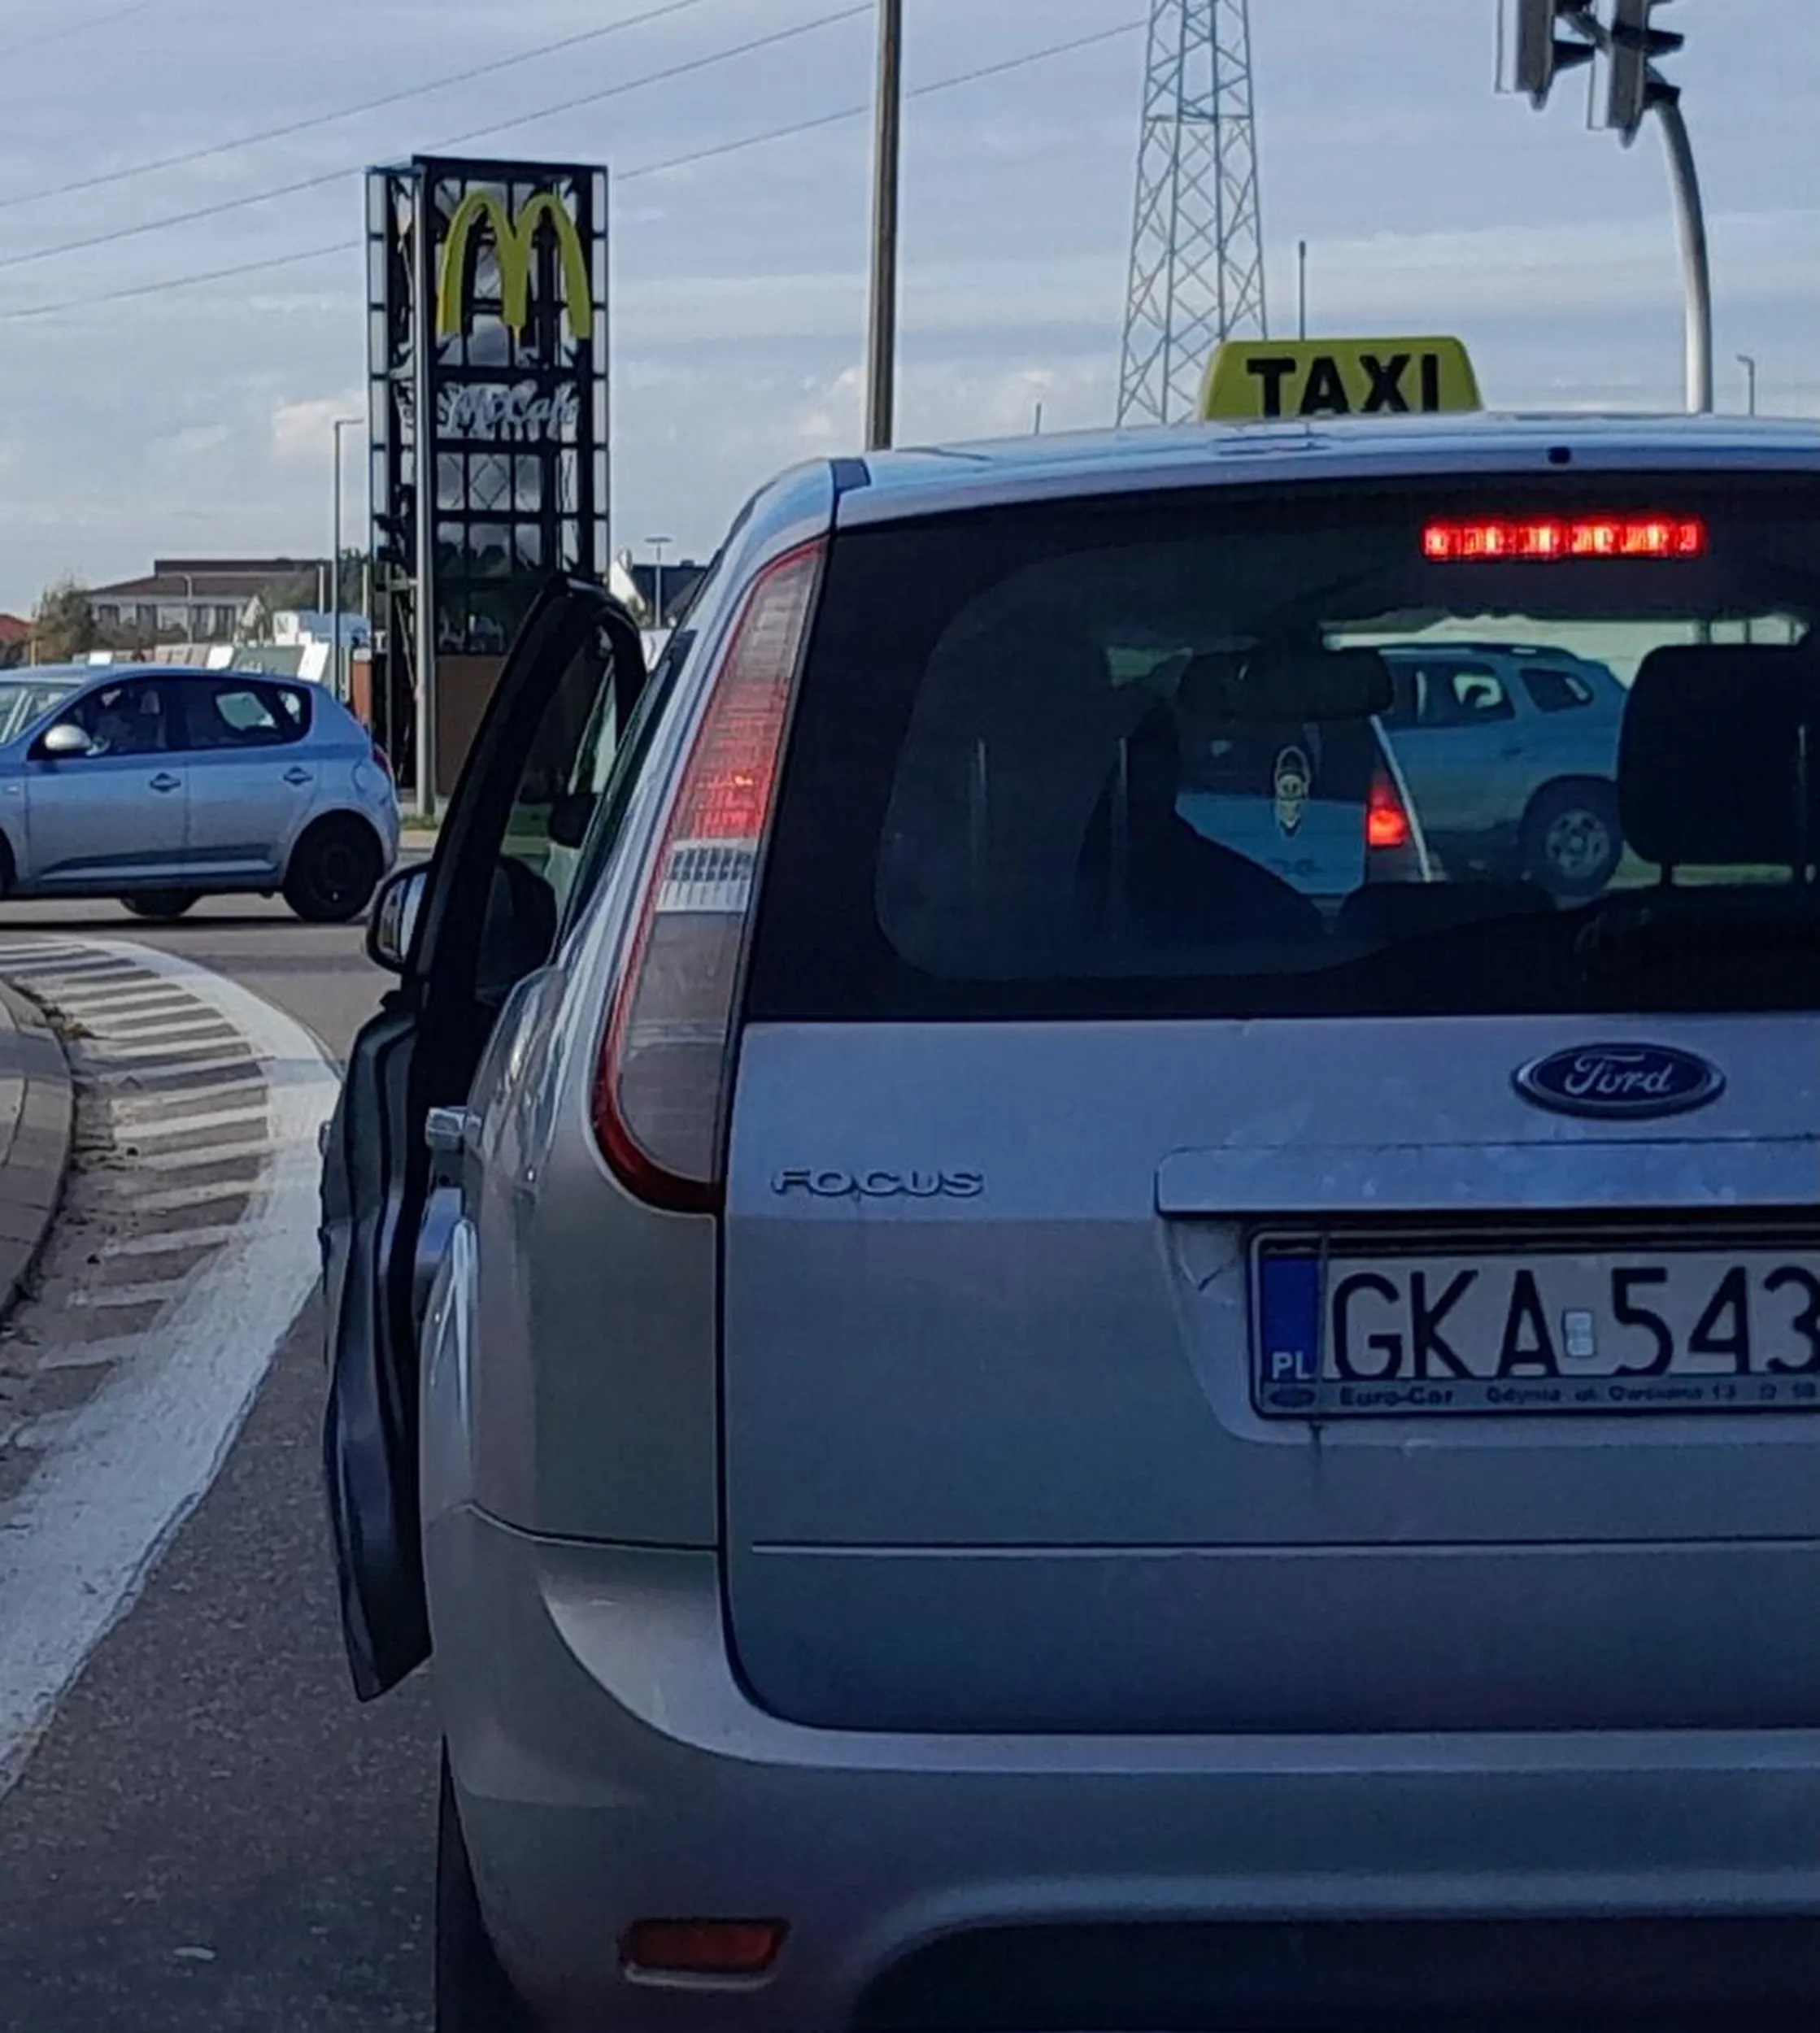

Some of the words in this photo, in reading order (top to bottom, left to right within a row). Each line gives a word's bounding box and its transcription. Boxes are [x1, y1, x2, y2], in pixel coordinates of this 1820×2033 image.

[1247, 354, 1439, 417] TAXI
[1564, 1054, 1672, 1095] Ford
[771, 1168, 984, 1196] FOCUS
[1332, 1269, 1560, 1381] GKA
[1611, 1265, 1820, 1376] 543
[1271, 1350, 1310, 1381] PL
